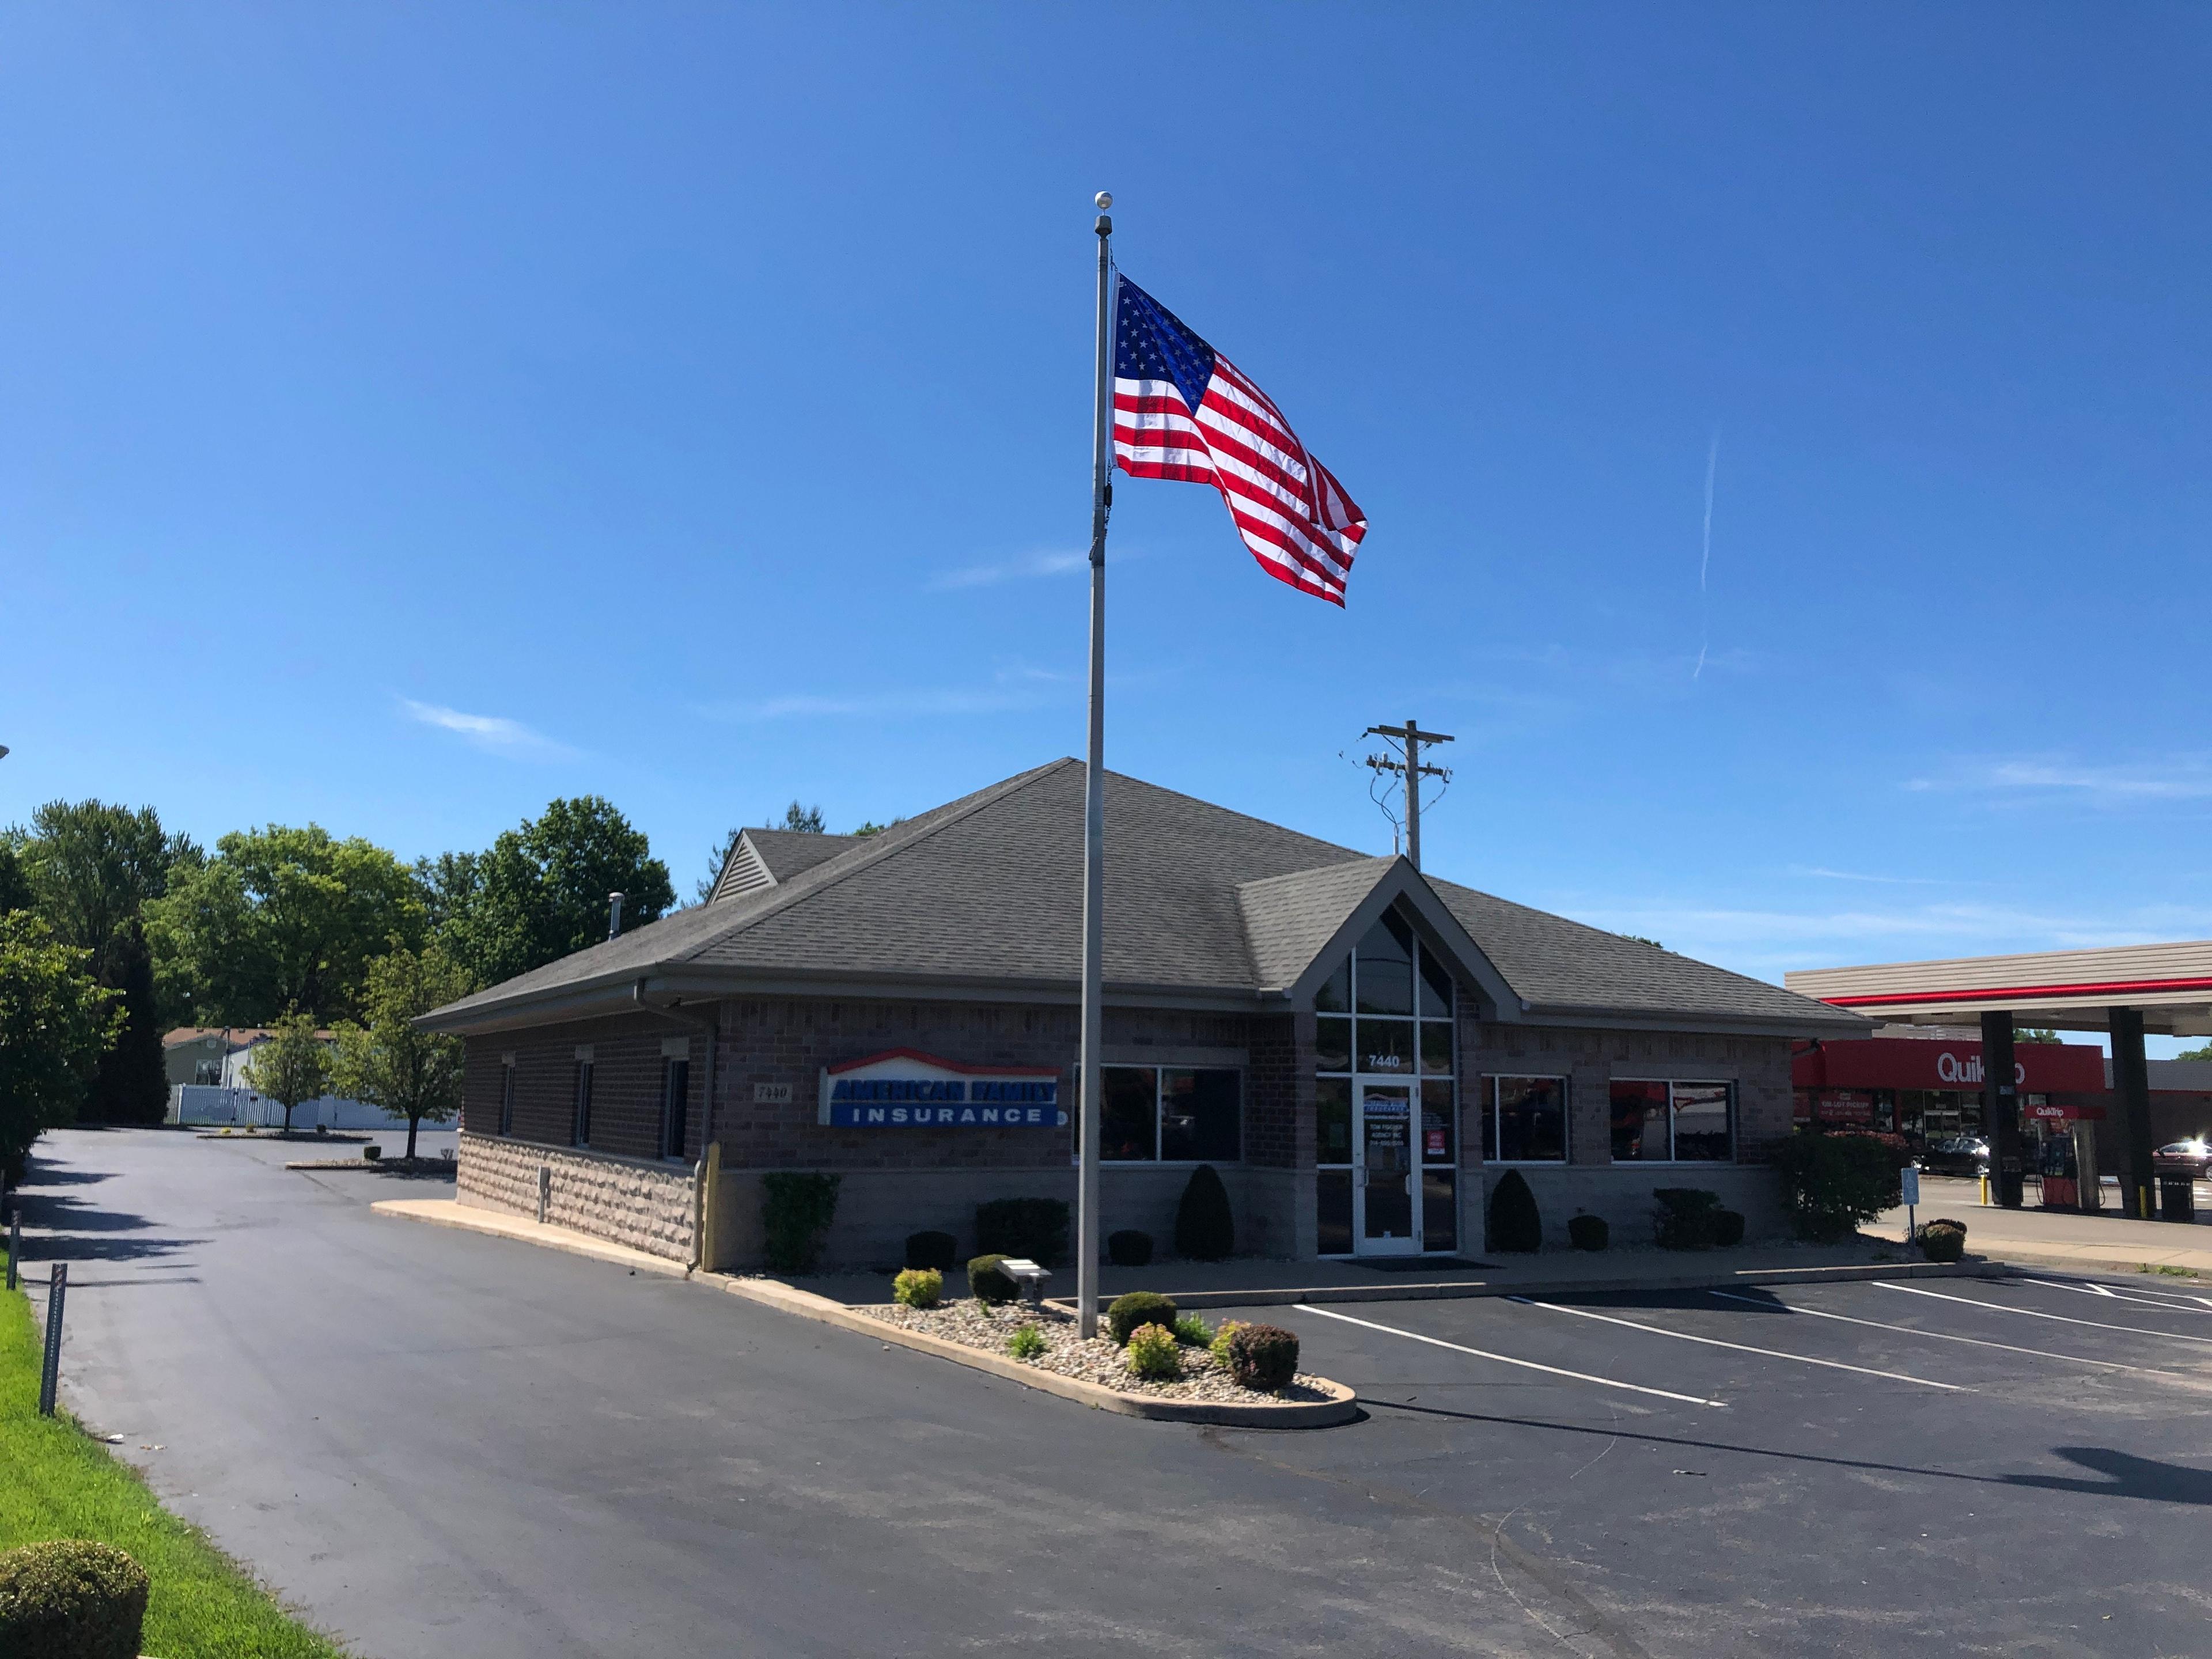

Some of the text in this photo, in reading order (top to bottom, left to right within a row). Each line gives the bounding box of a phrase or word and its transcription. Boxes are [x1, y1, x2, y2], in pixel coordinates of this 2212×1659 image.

[1369, 1055, 1399, 1067] 7440
[1937, 1052, 2025, 1084] Quik
[759, 1086, 787, 1099] 7440
[832, 1080, 1056, 1102] AMERICAN FAMILY
[853, 1108, 1041, 1123] INSURANCE
[2036, 1107, 2063, 1117] QuikTrip
